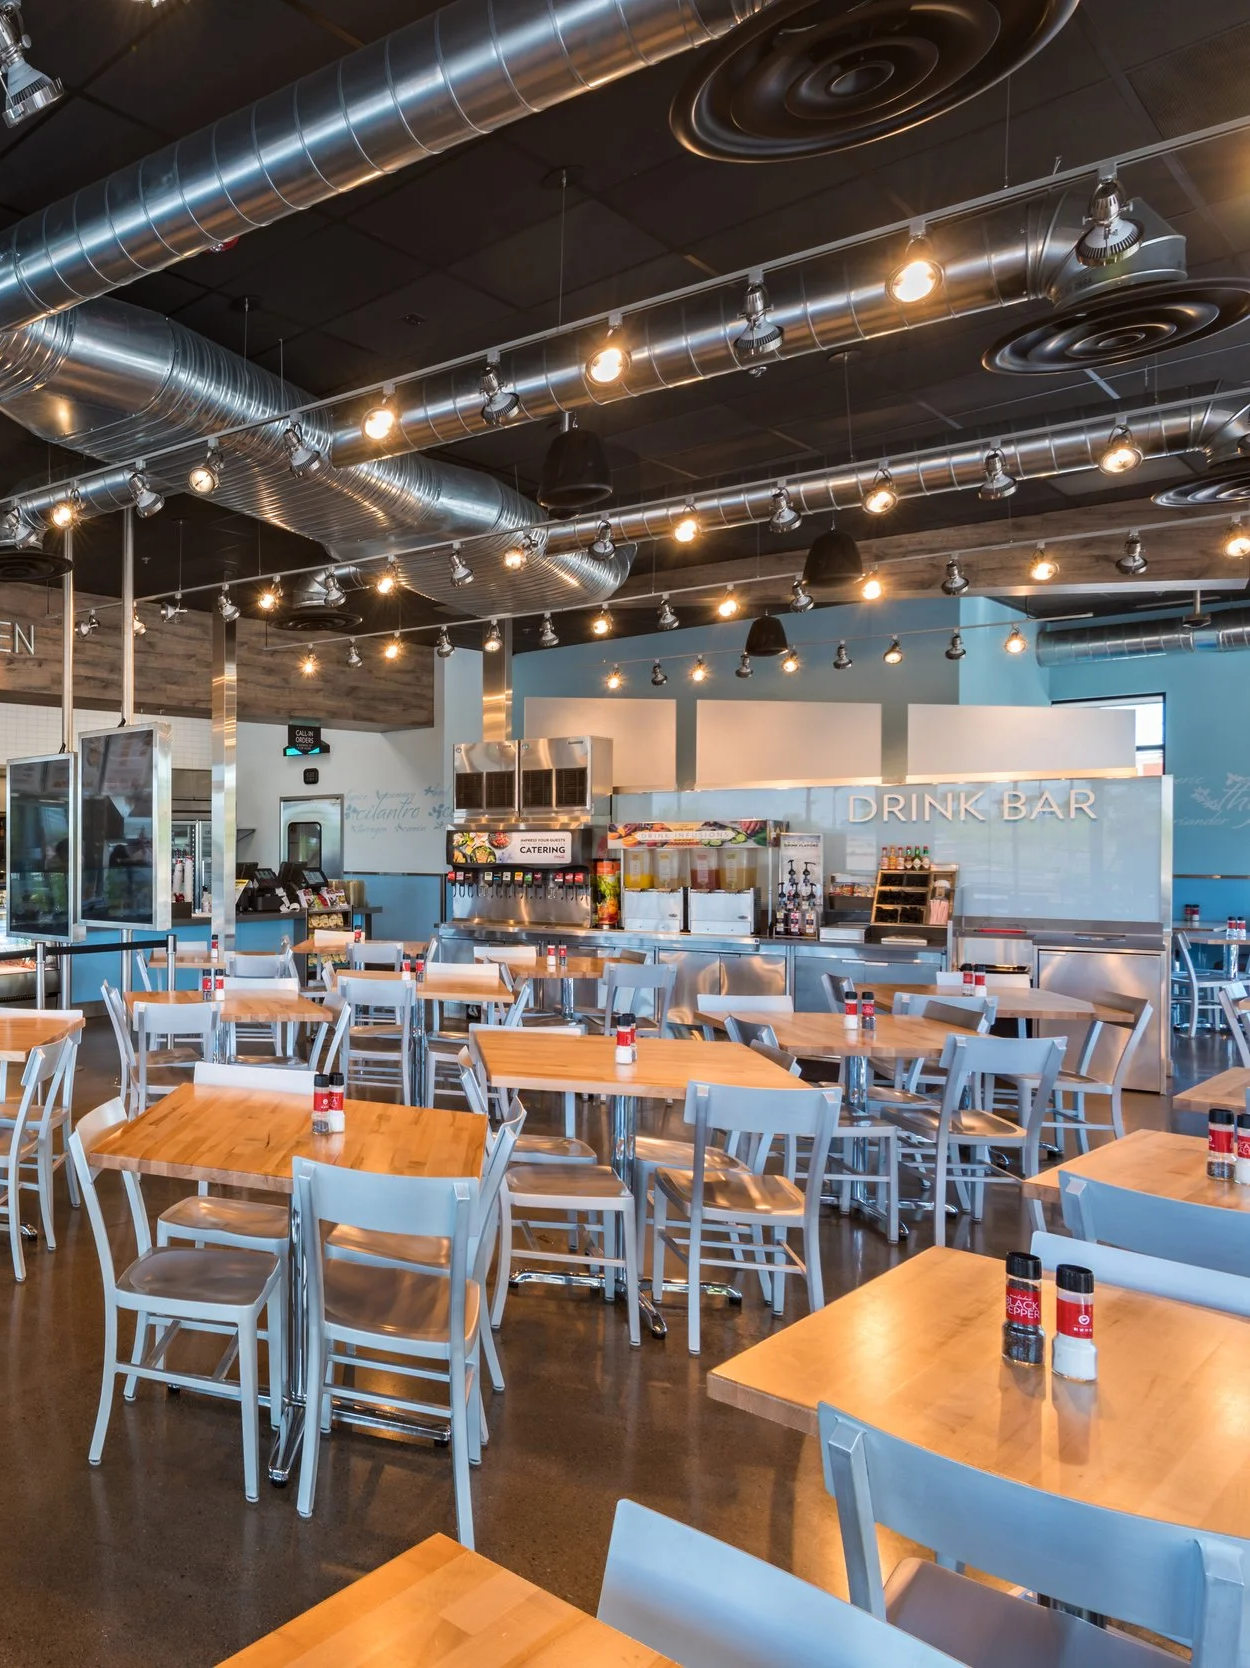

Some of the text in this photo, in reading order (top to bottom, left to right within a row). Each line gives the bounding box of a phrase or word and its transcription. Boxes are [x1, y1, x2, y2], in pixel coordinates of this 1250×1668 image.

[295, 729, 314, 737] CALL-IN
[356, 794, 422, 821] cilantro
[848, 789, 1098, 823] DRINK BAR
[640, 831, 670, 840] DRINK
[674, 830, 730, 839] INFUSIONS
[519, 846, 566, 854] CATERING
[1006, 1295, 1039, 1311] BLACK
[1006, 1303, 1040, 1319] EPPER
